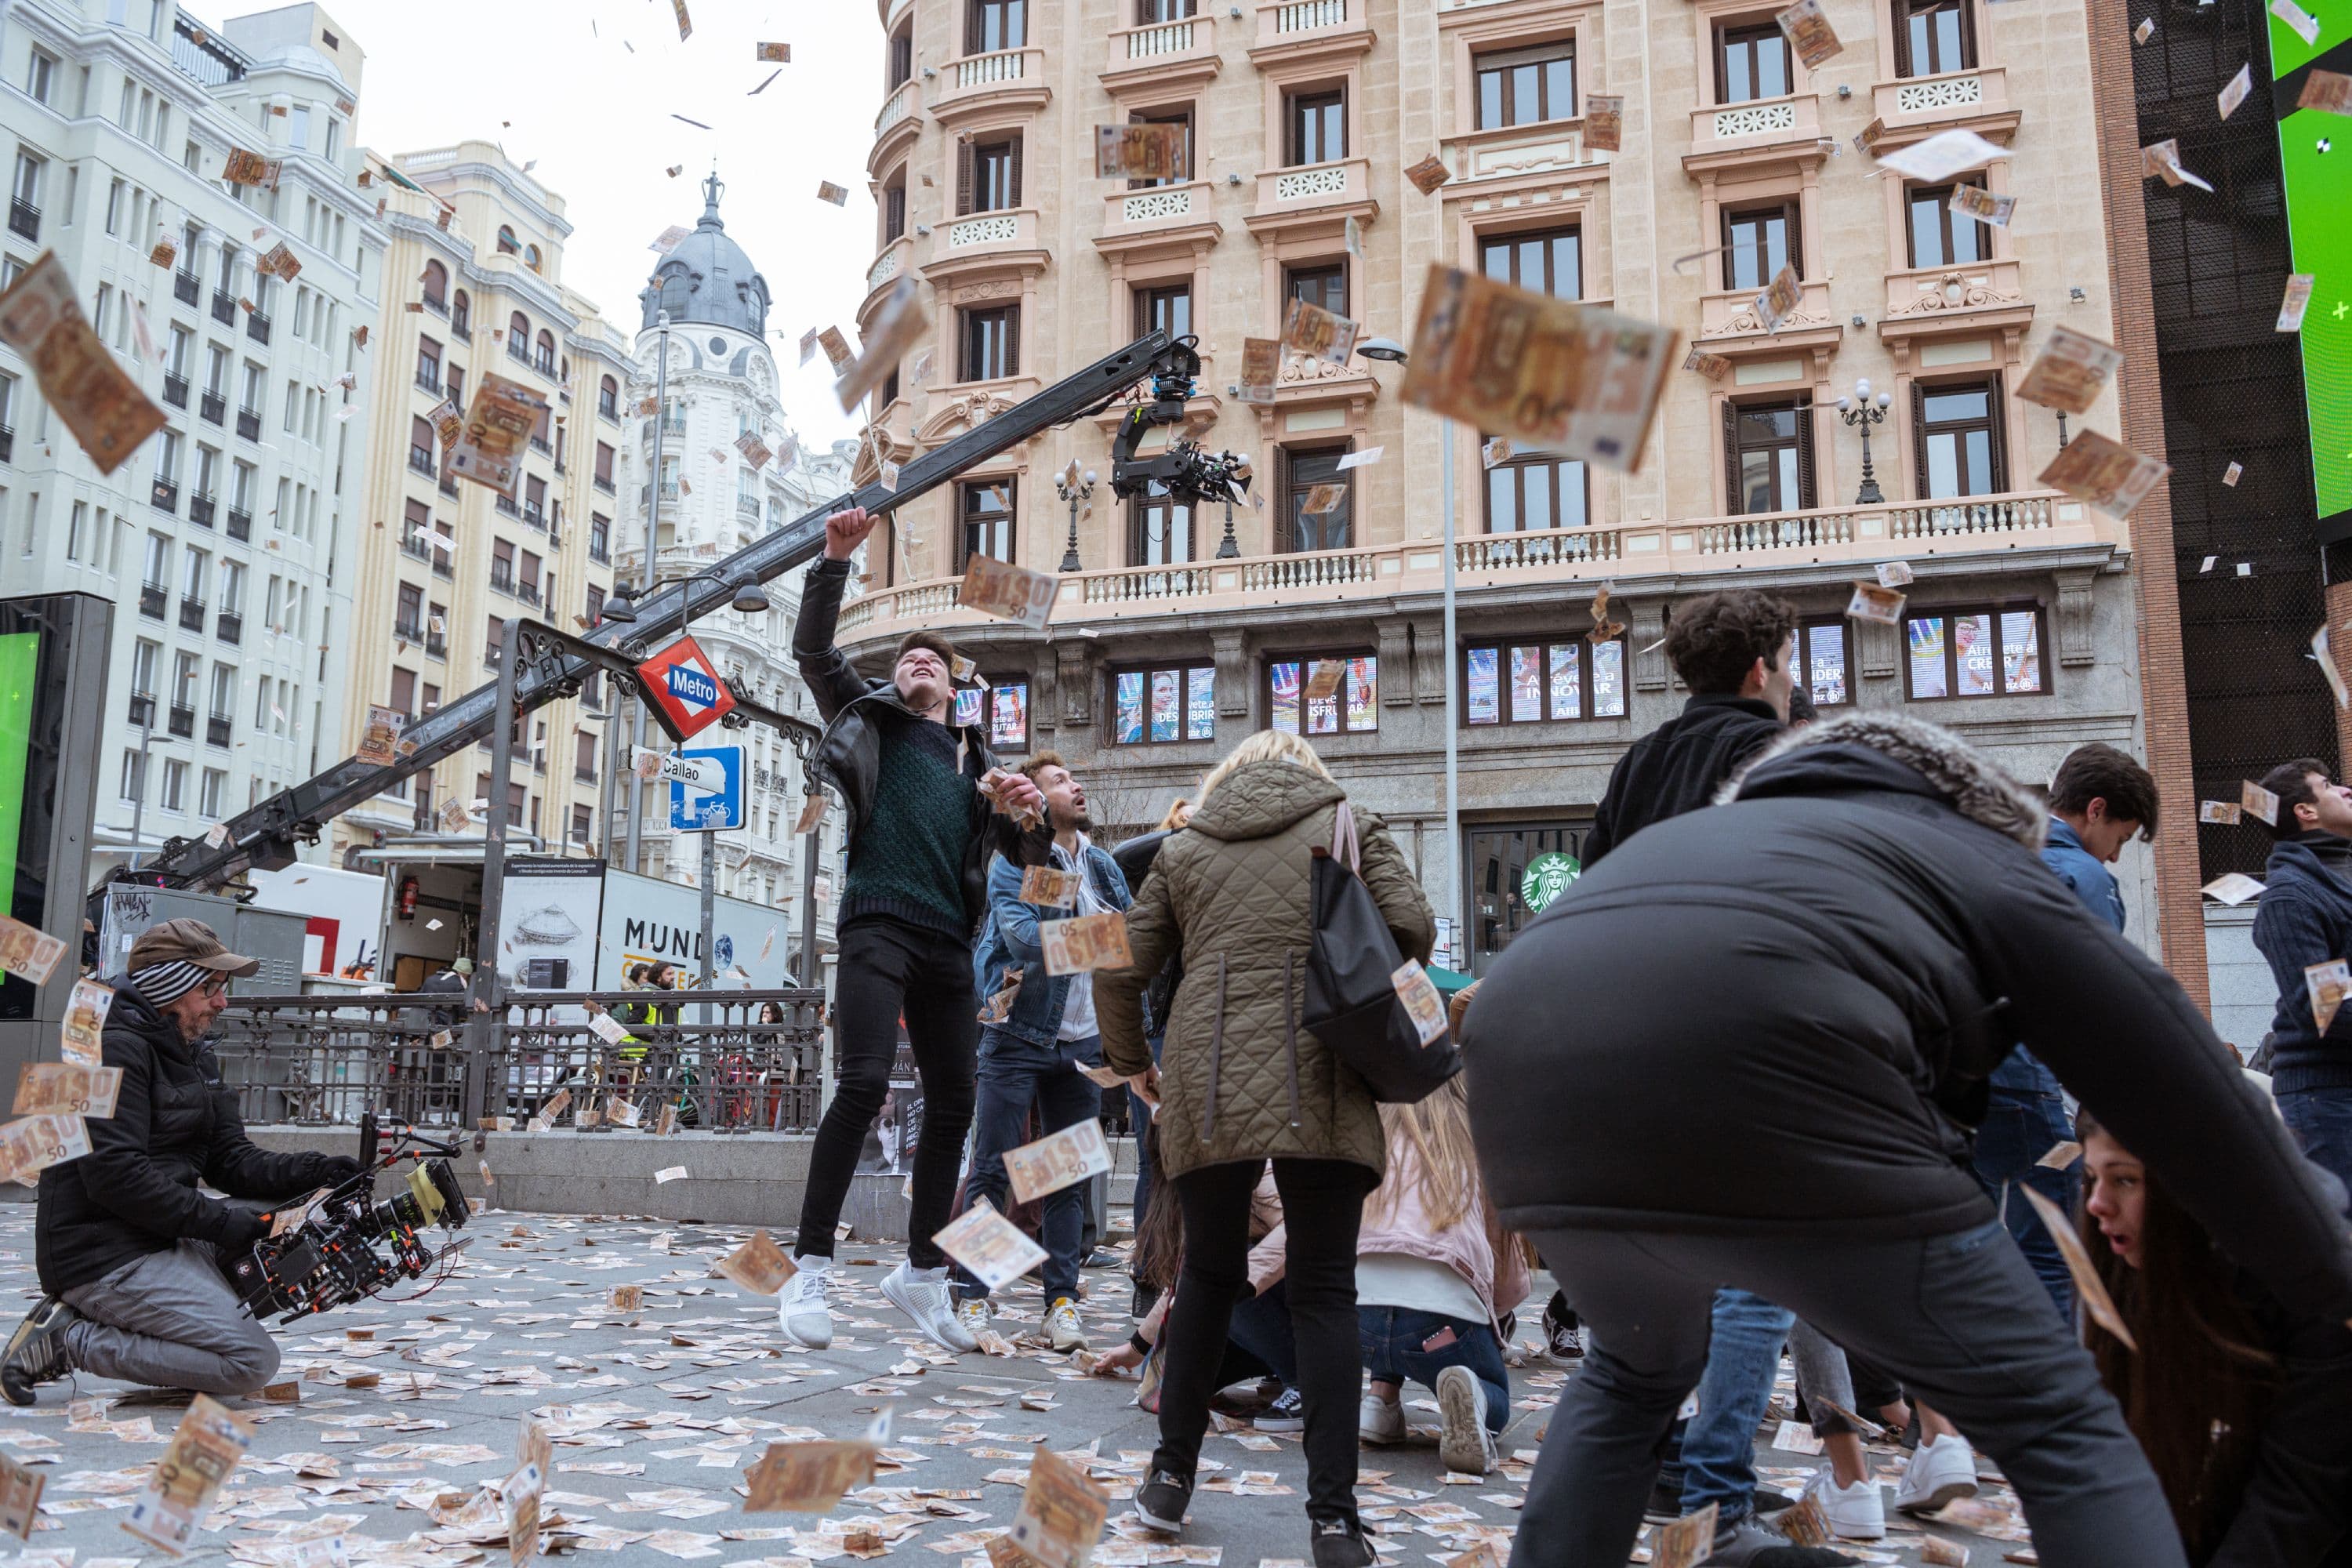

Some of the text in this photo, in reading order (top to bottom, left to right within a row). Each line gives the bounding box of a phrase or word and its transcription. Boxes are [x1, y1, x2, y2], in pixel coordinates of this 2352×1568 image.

[1968, 657, 2013, 669] CRER
[673, 670, 714, 702] Metro
[664, 758, 699, 781] Callao
[7, 956, 27, 973] 50
[68, 1099, 90, 1113] 50
[46, 1145, 67, 1162] 50
[1068, 1161, 1088, 1178] 50
